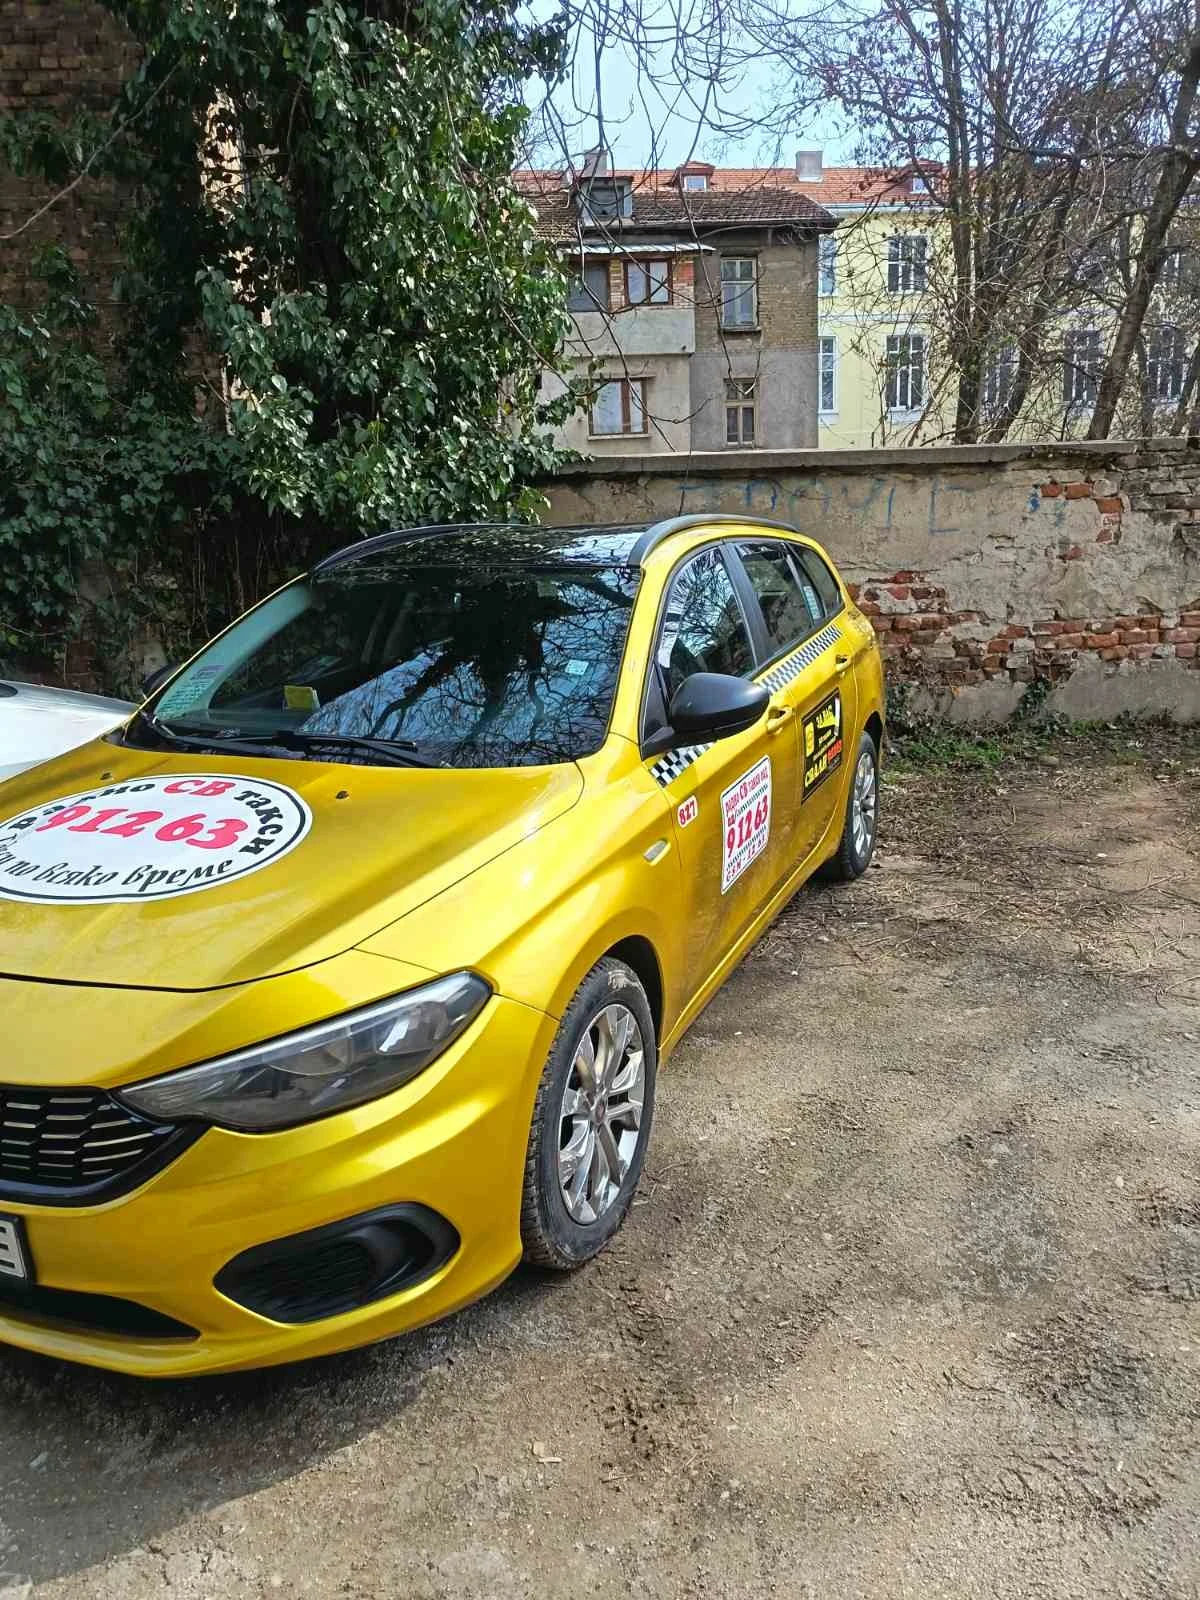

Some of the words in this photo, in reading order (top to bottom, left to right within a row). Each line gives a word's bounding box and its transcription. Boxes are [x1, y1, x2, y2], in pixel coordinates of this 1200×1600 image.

[163, 779, 237, 797] СВ
[678, 800, 696, 826] 827
[32, 862, 119, 887] всяко
[121, 860, 233, 893] време
